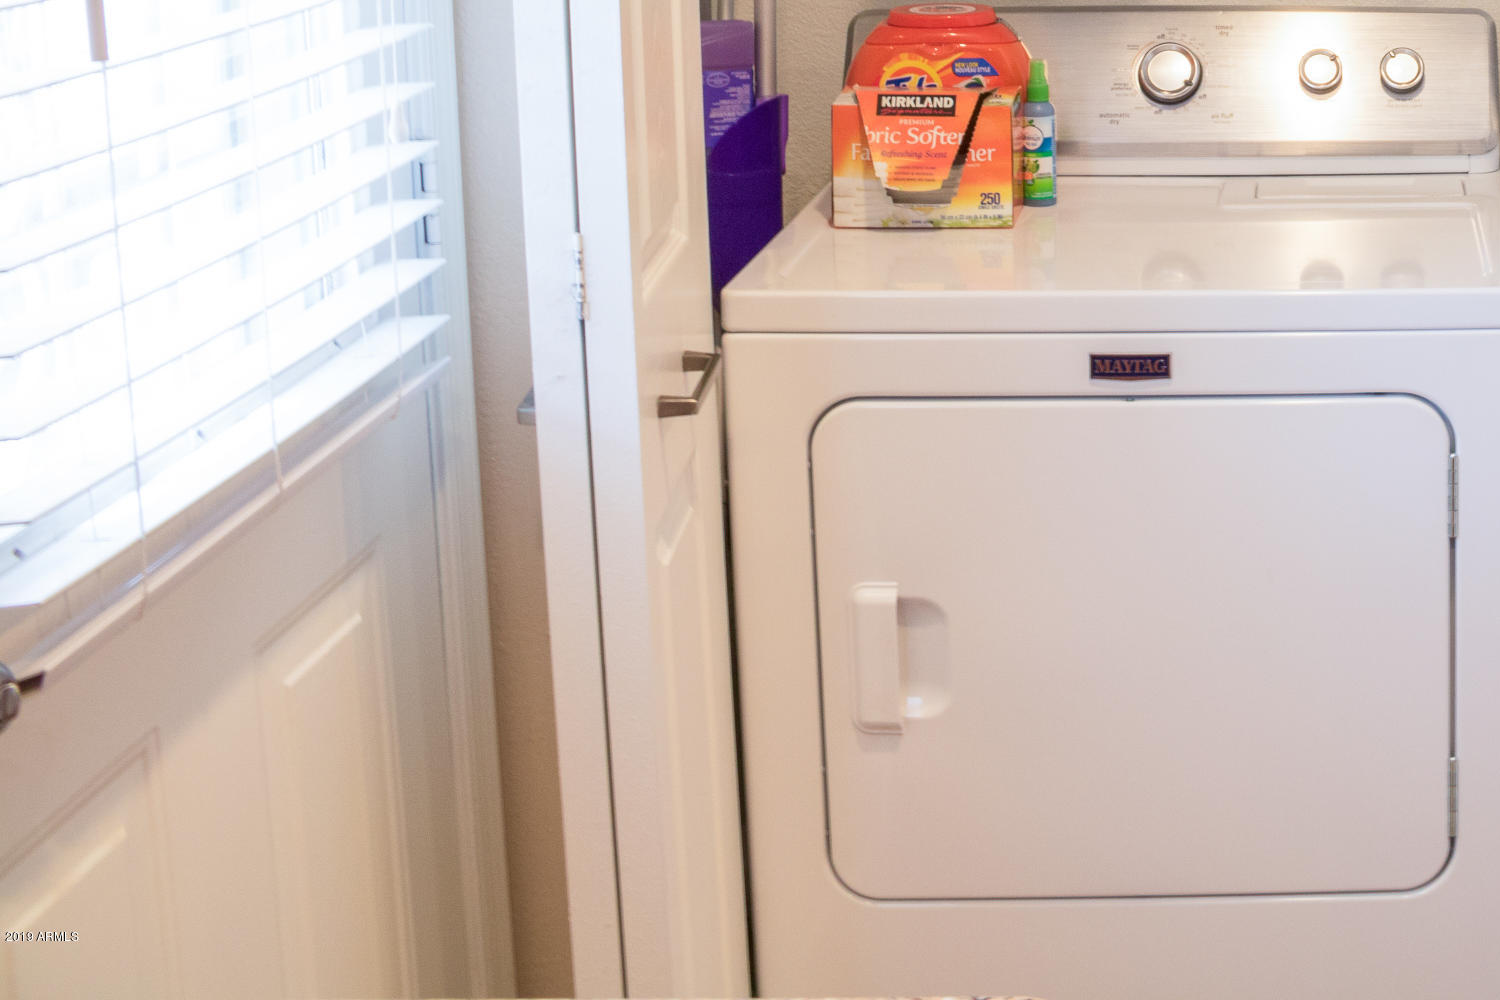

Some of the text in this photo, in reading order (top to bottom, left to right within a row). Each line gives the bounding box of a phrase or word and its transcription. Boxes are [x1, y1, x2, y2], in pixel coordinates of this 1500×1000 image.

[881, 96, 954, 108] KIRKLAND
[980, 193, 1001, 205] 250
[1094, 359, 1168, 373] MAYTAG
